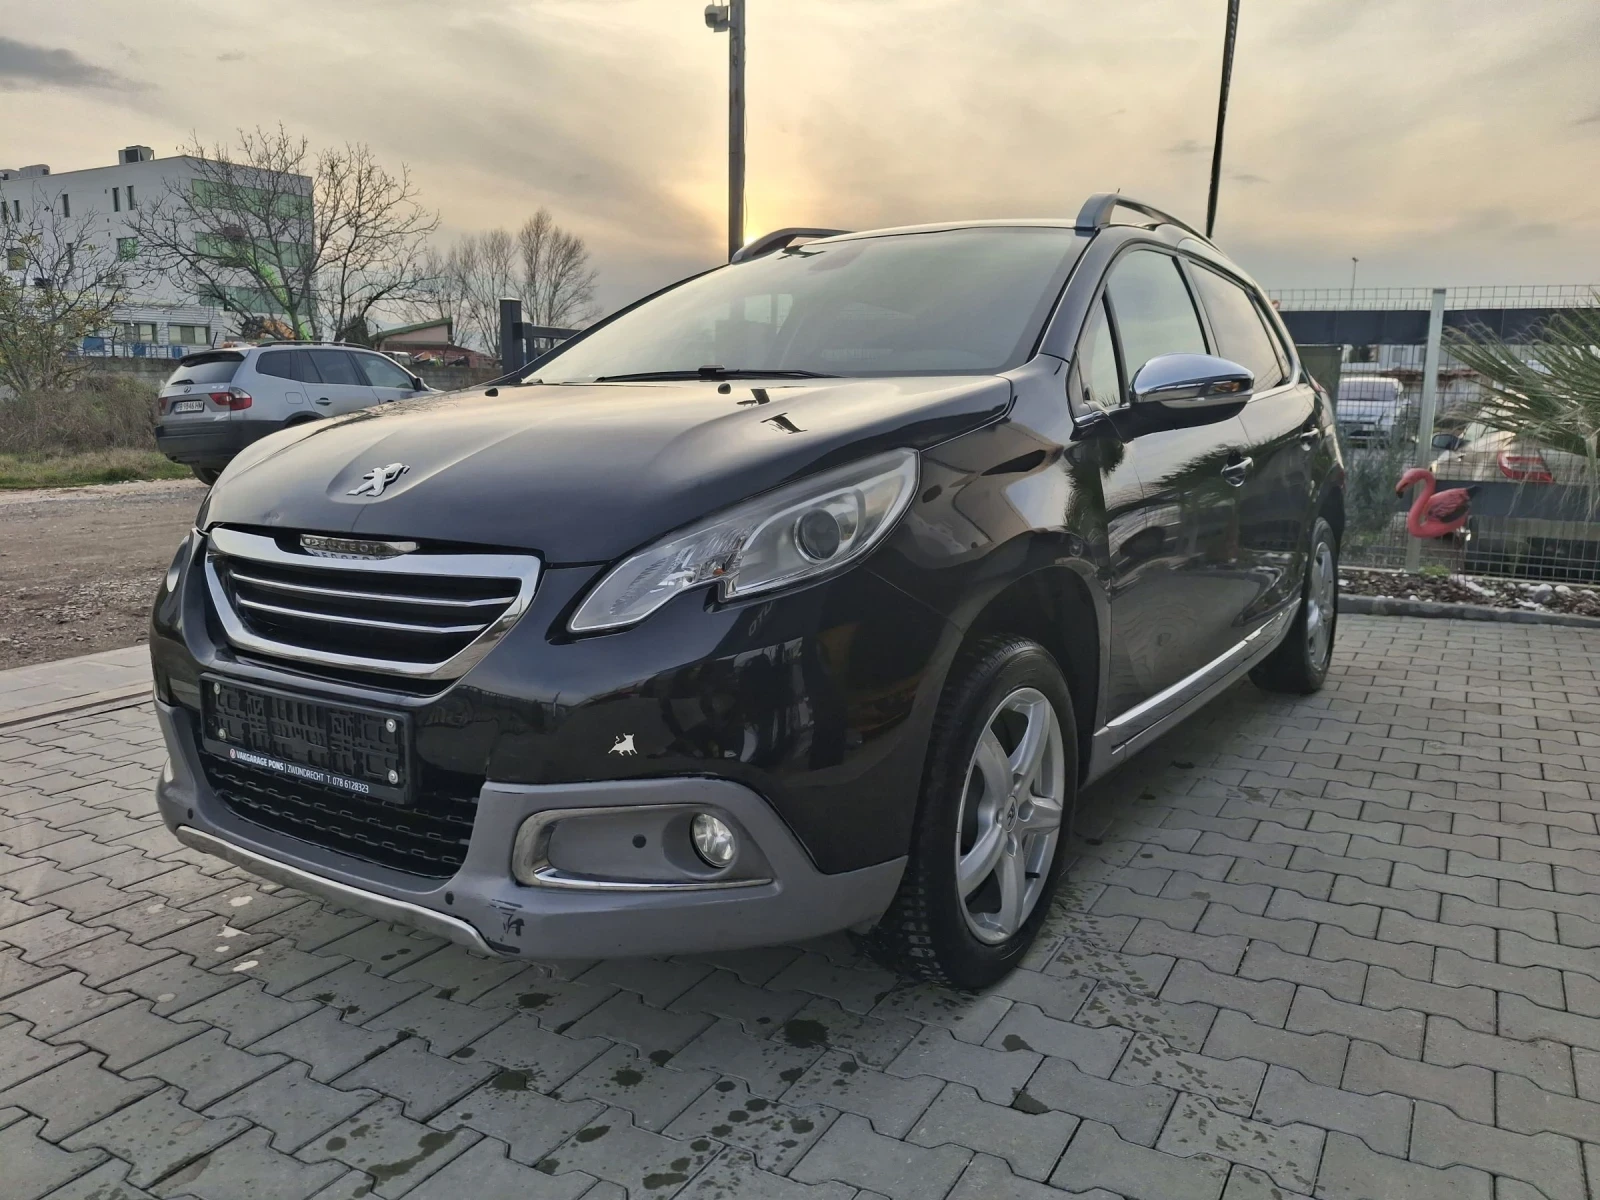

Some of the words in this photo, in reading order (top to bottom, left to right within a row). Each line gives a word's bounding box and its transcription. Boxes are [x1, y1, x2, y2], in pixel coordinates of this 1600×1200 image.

[268, 759, 284, 771] PONS
[332, 776, 344, 788] 078
[344, 779, 369, 794] 6128323
